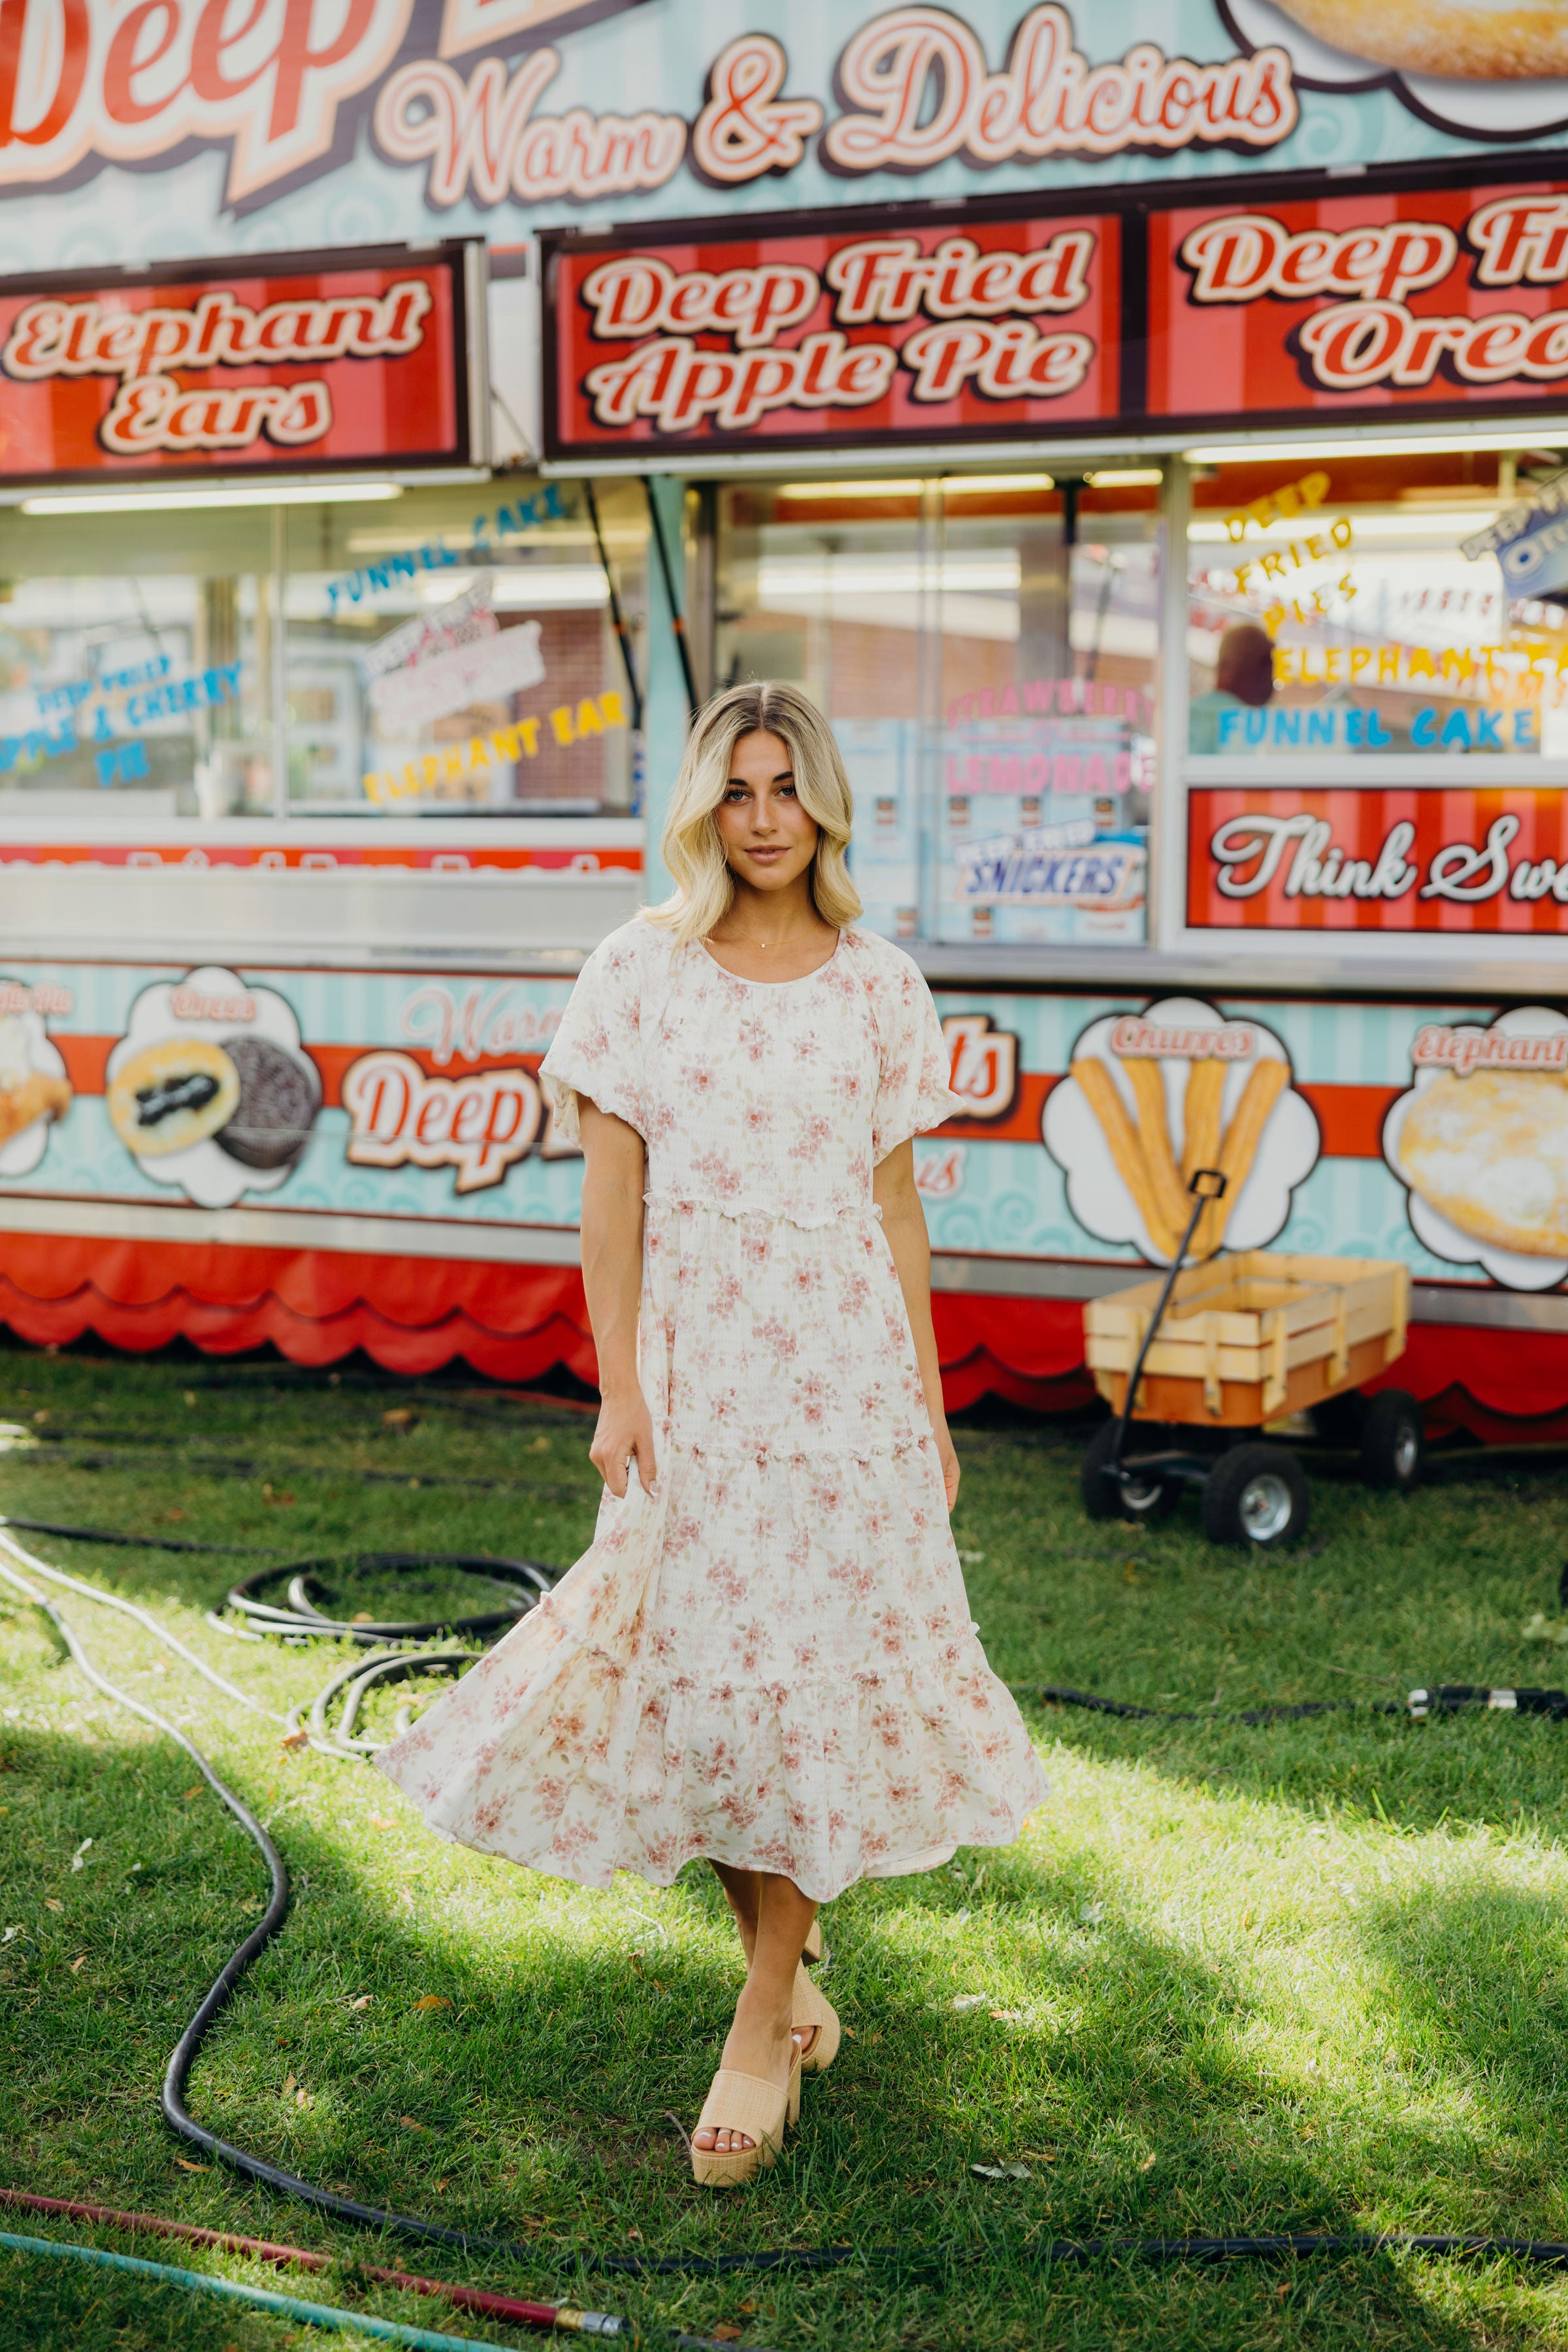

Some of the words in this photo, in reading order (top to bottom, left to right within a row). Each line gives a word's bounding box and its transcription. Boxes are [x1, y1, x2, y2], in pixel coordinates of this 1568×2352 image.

[376, 47, 687, 204] Warm
[693, 34, 822, 182] &
[826, 5, 1298, 169] Delicious
[584, 257, 819, 348] Deep
[826, 231, 1096, 323] Fried
[1181, 215, 1457, 302] Deep
[4, 280, 430, 382] Elephant
[99, 375, 333, 452] Ears
[585, 333, 896, 433] Apple
[903, 320, 1094, 400] Pie
[326, 536, 457, 613] FUNNEL
[472, 482, 566, 553] CAKE
[1223, 470, 1331, 543] DEEP
[1232, 516, 1352, 596] FRIED
[1262, 572, 1358, 640] PIES
[1273, 643, 1504, 683] ELEPHANT
[363, 717, 540, 804] ELEPHANT
[1217, 708, 1393, 747] FUNNEL
[1410, 707, 1534, 749] CAKE
[964, 853, 1126, 895] SNICKERS
[1211, 813, 1417, 899] Think
[1110, 1015, 1254, 1058] Churros
[343, 1051, 542, 1186] Deep
